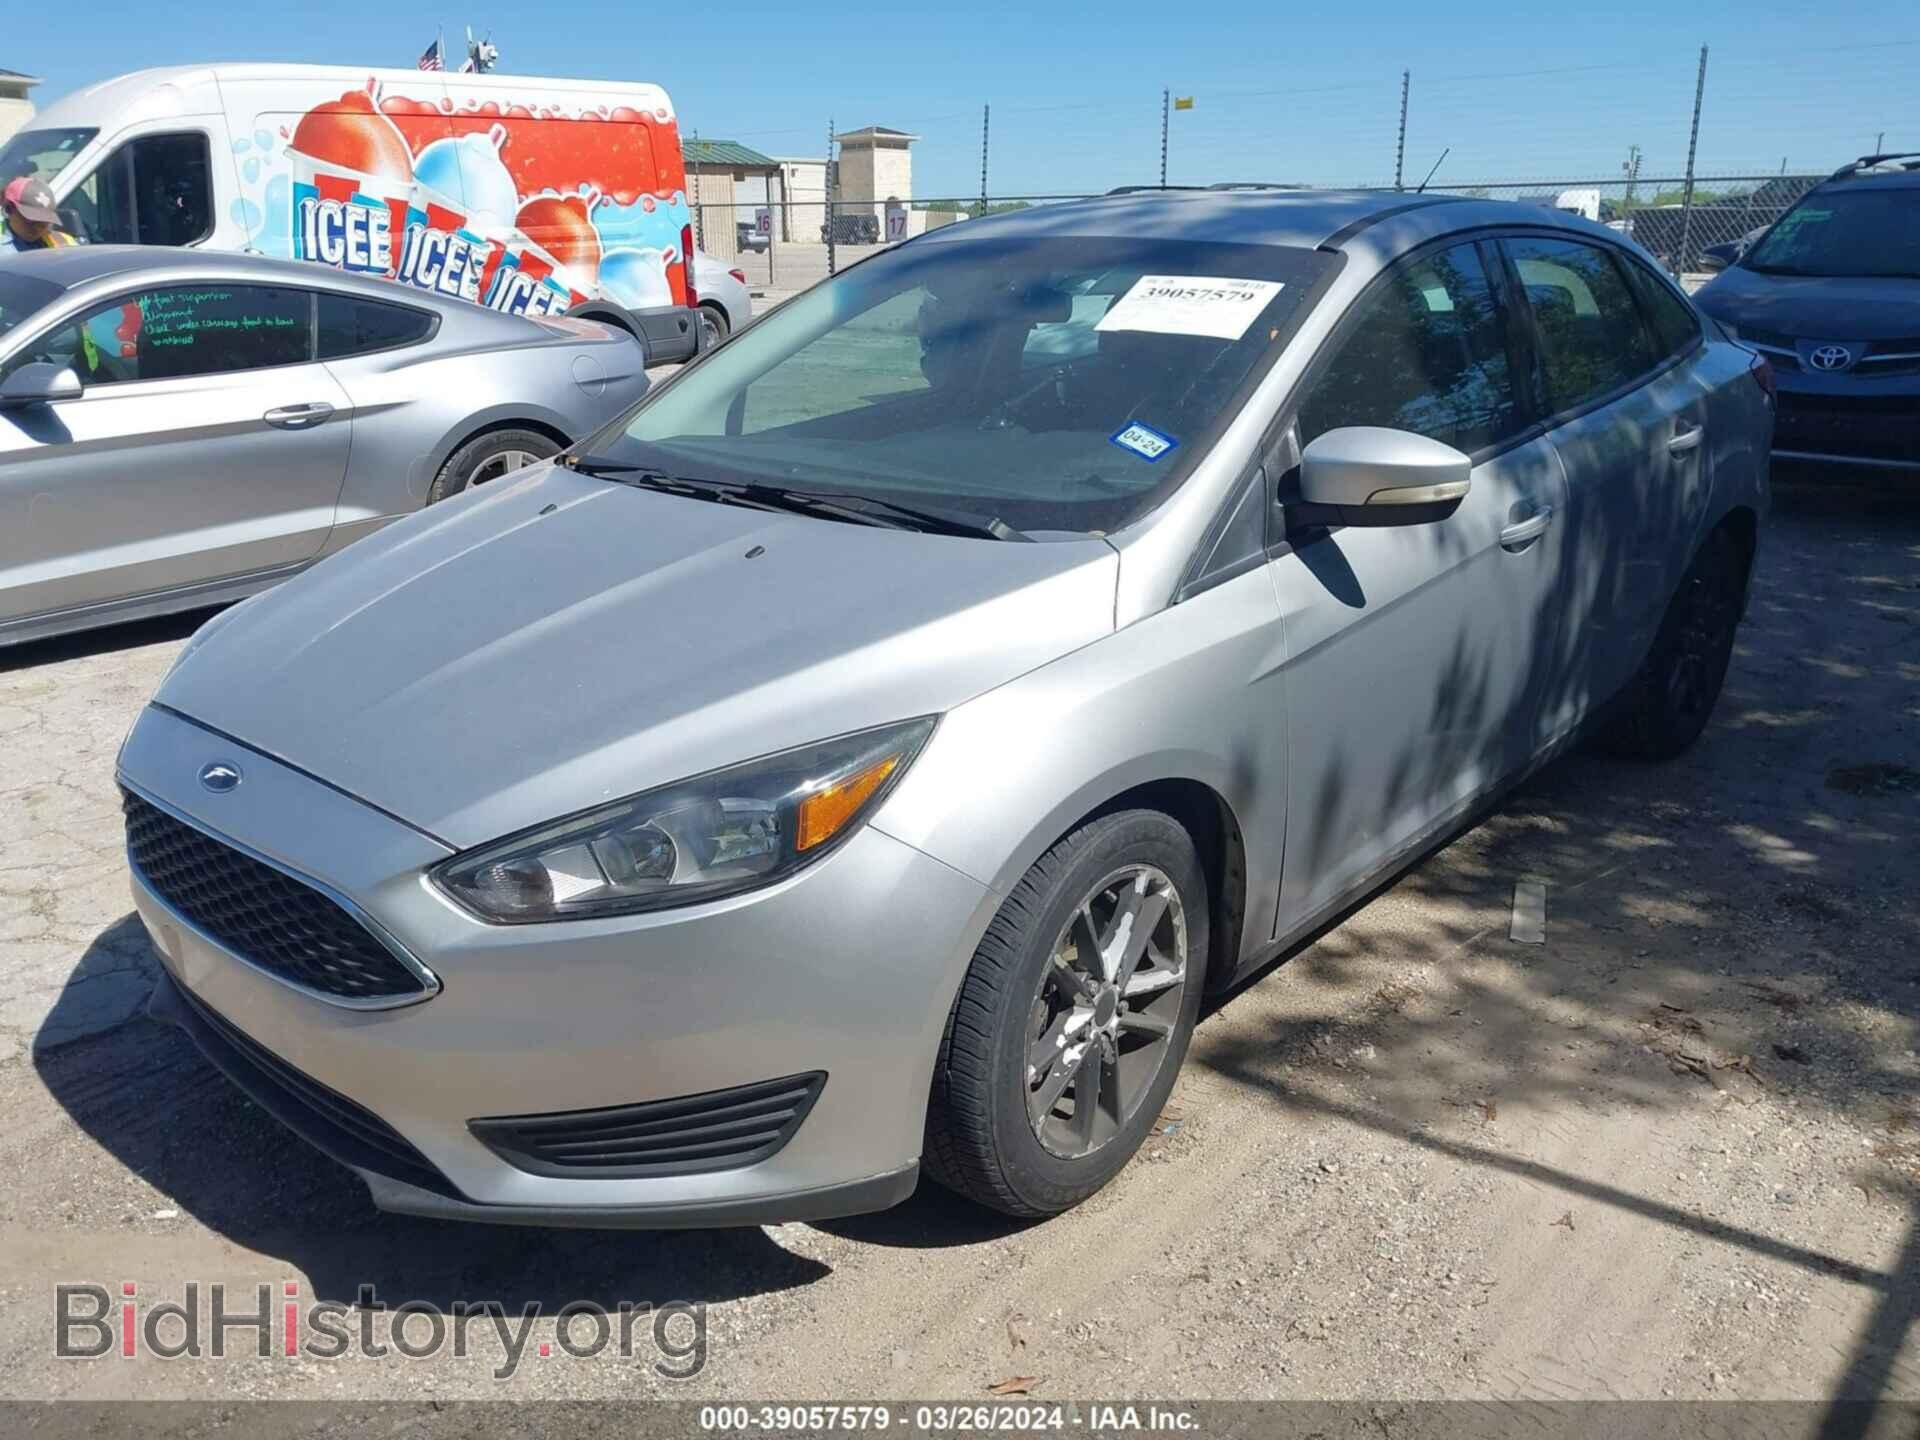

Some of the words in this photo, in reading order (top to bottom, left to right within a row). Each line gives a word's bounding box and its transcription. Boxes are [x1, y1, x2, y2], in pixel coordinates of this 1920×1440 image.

[756, 215, 770, 232] 16
[889, 216, 905, 235] 17
[301, 199, 391, 273] ICEE
[402, 223, 492, 303] ICEE
[1141, 287, 1255, 301] 39057579
